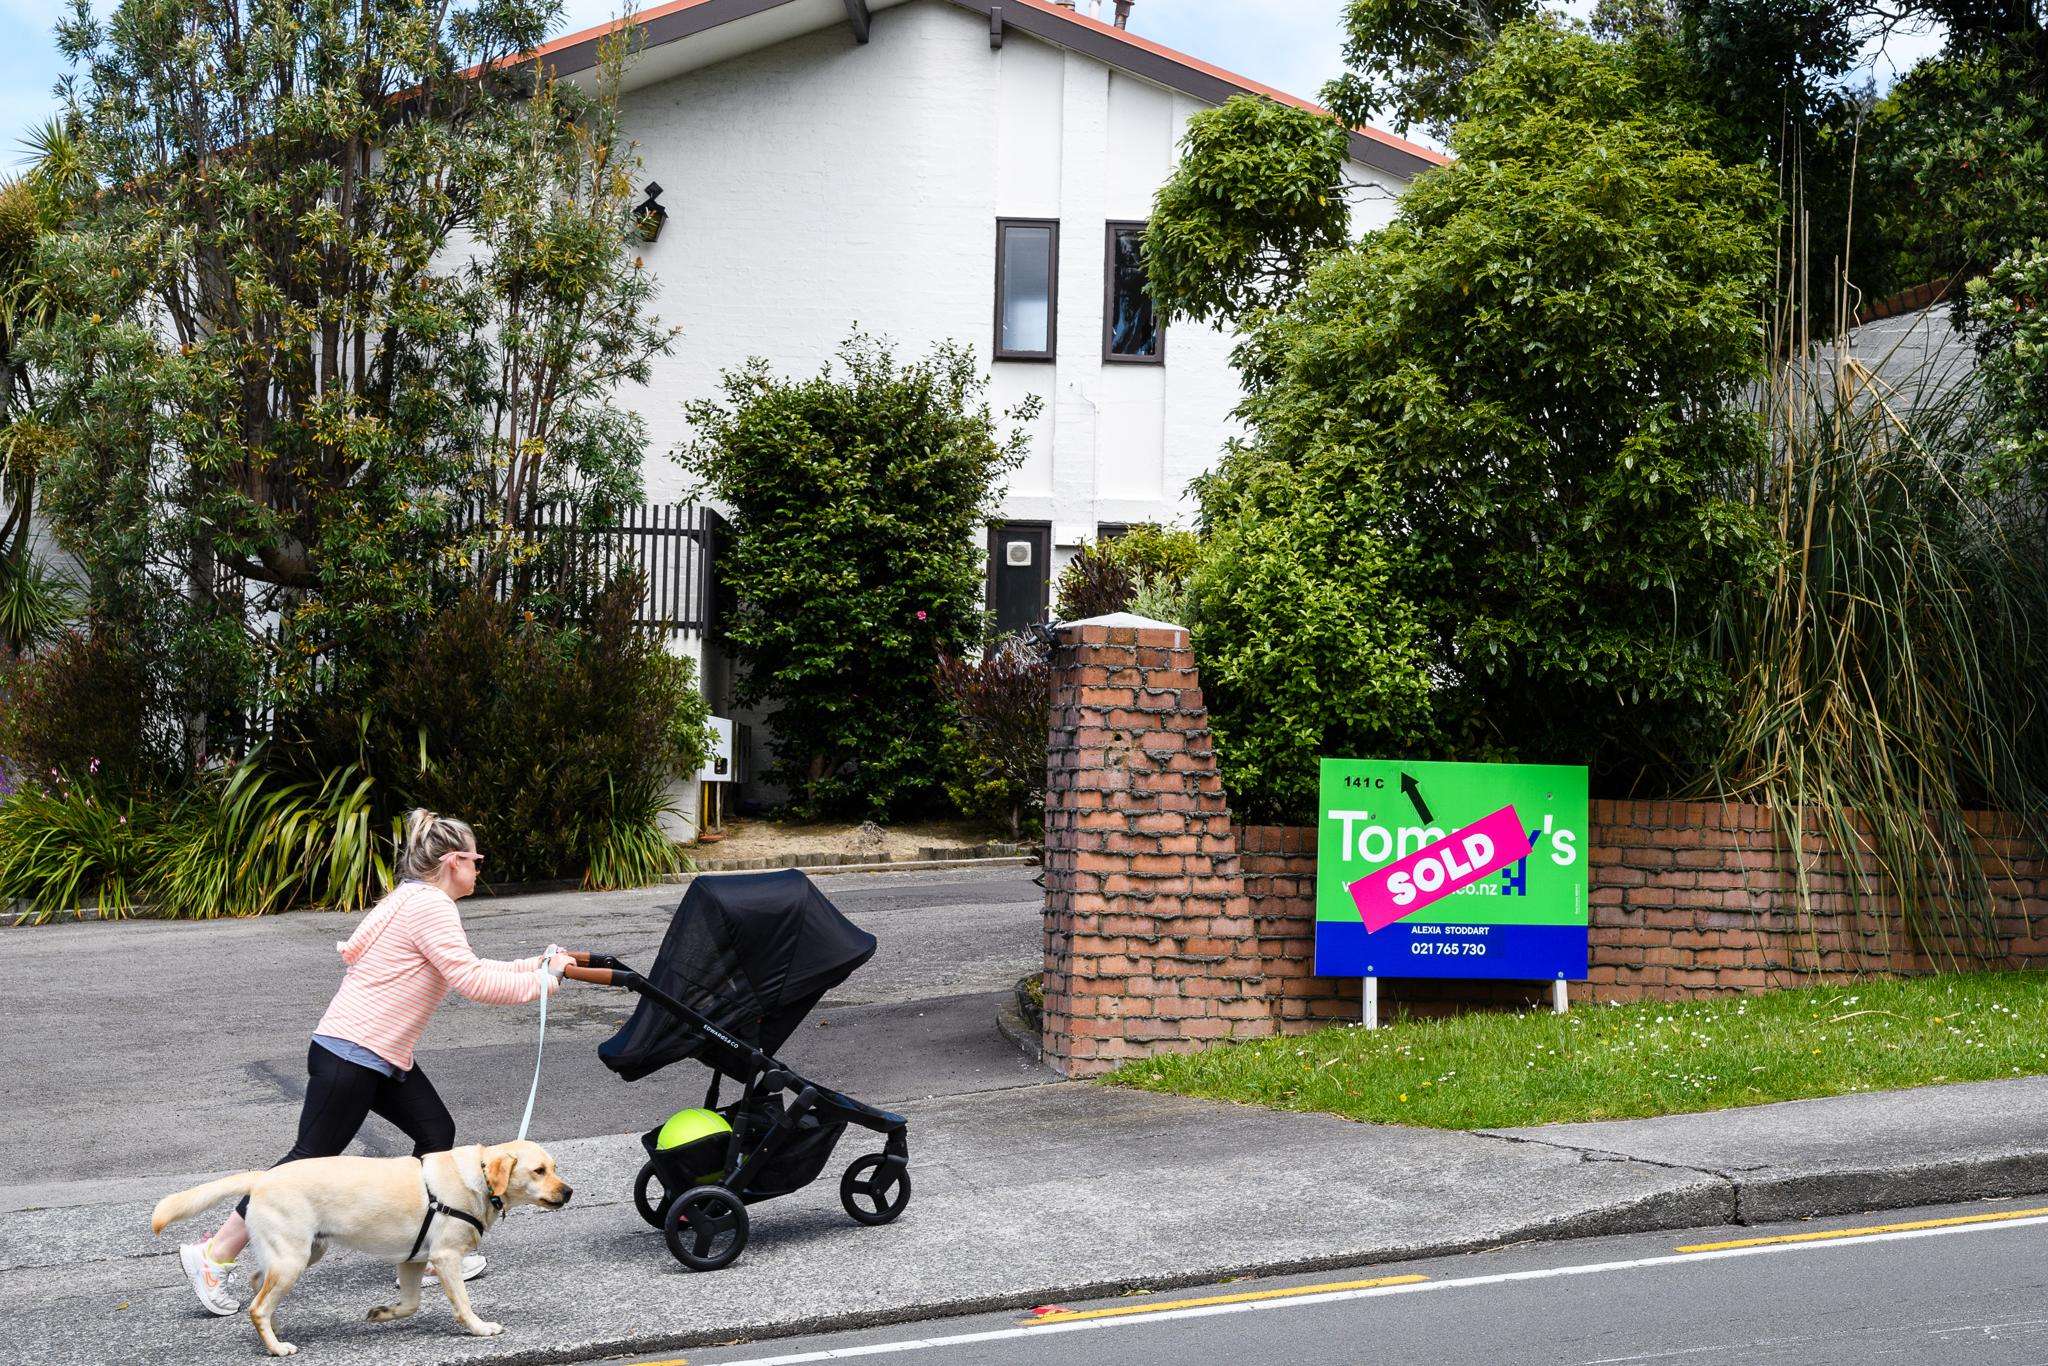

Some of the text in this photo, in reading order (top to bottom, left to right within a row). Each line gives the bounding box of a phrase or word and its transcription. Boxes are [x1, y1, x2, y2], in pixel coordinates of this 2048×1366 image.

[1344, 775, 1385, 789] 141 C
[1386, 832, 1496, 906] SOLD
[1411, 925, 1490, 936] ALEXIA STODDART
[1411, 942, 1487, 956] 021 765 730
